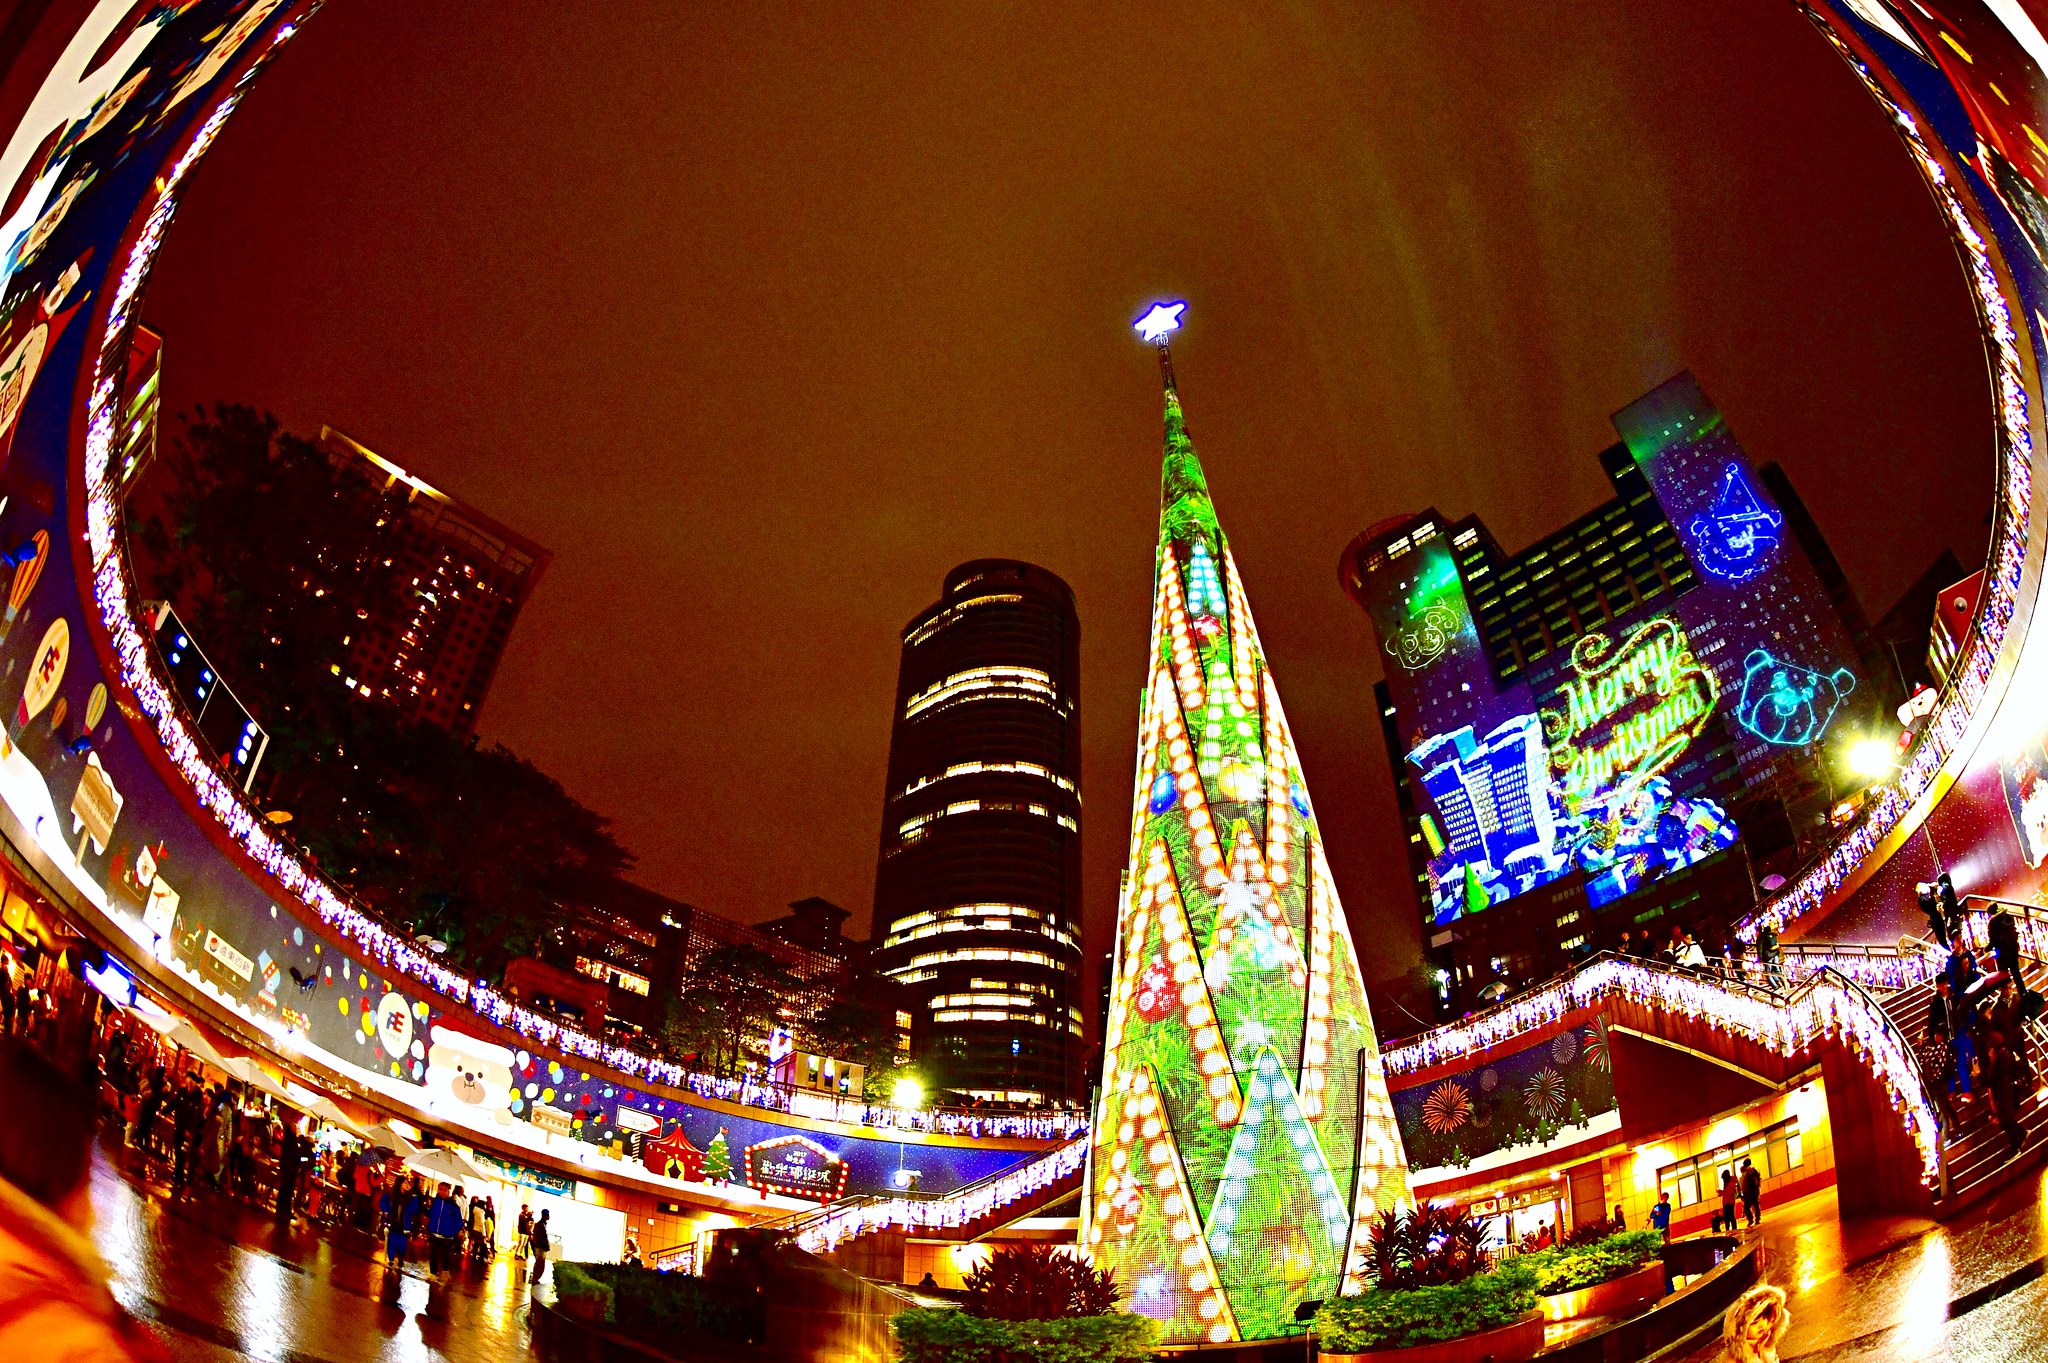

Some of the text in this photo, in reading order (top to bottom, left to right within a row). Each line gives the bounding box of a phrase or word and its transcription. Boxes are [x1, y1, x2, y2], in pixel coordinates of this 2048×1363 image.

[1555, 620, 1678, 732] Merry
[1556, 674, 1706, 790] Christmas
[760, 1159, 831, 1183] 歡樂耶誕城
[793, 1150, 808, 1158] 2017
